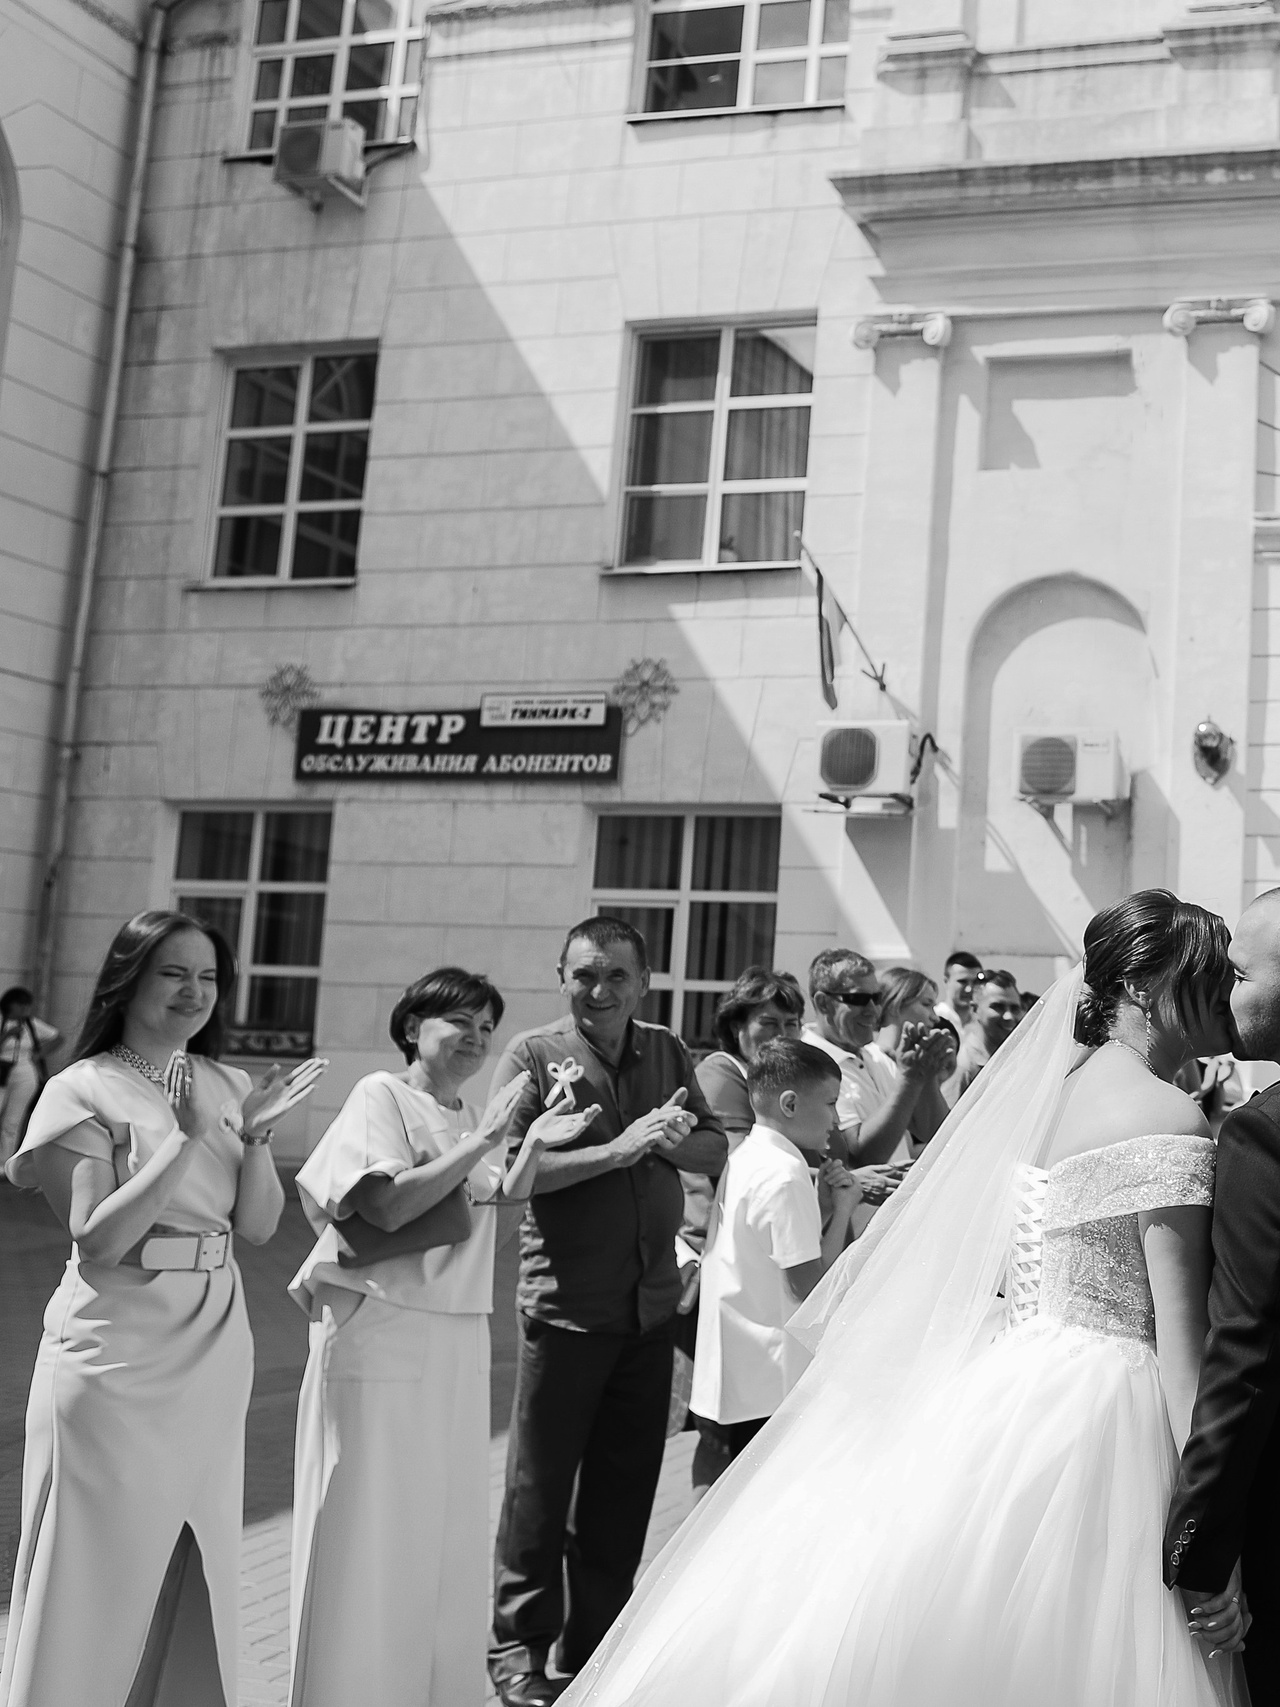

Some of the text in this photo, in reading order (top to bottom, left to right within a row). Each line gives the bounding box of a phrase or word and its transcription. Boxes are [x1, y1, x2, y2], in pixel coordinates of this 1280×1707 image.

[315, 713, 466, 748] ЦЕНТР
[300, 753, 613, 774] ОБСЛУЖИВАНИЯ АБОНЕНТОВ
